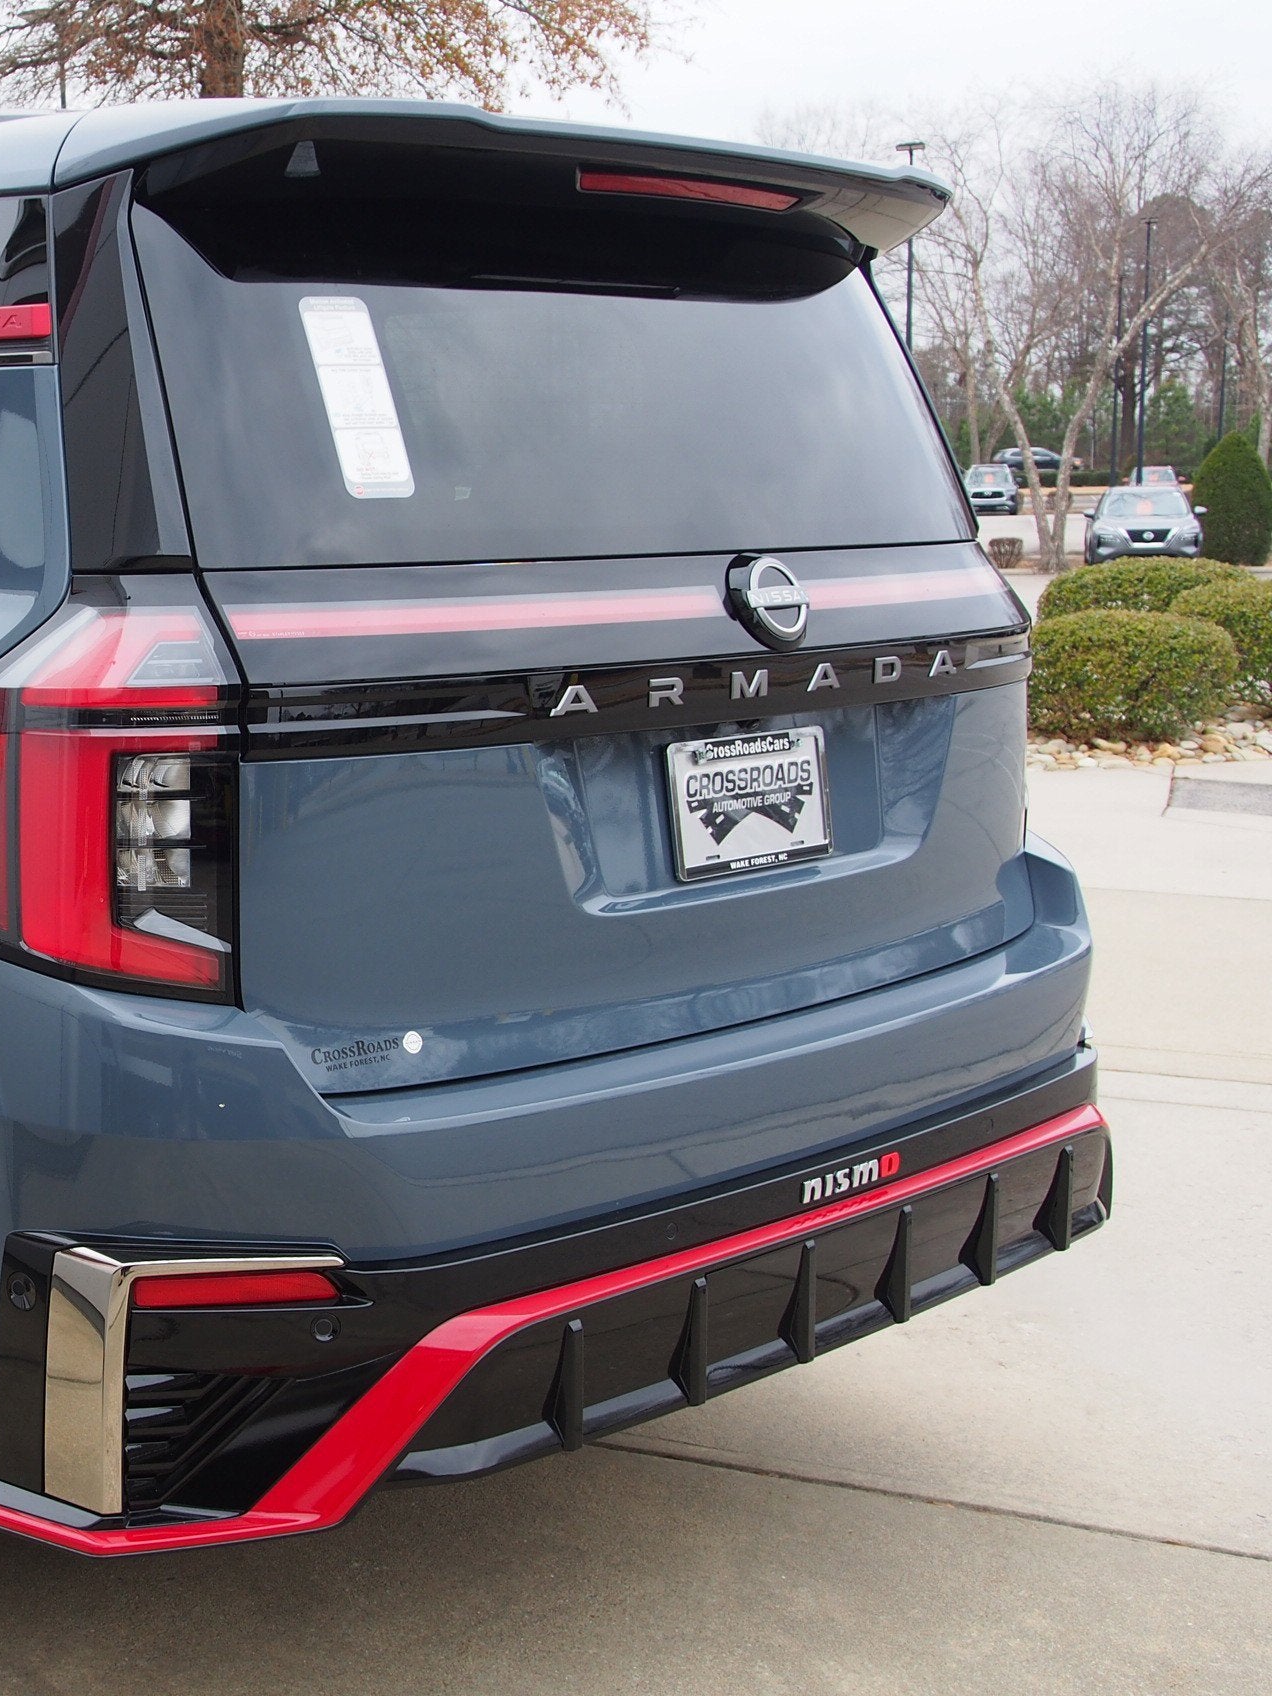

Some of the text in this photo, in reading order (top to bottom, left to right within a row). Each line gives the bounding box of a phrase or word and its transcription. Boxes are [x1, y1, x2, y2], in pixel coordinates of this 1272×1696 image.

[751, 589, 808, 604] NISSAN
[549, 649, 958, 717] ARMADA
[705, 737, 790, 760] CrossRoadsCars
[686, 759, 812, 799] CROSSROADS
[712, 791, 792, 813] AUTOMOTIVE GROUP
[730, 852, 789, 870] WAKE FOREST, NC
[325, 1053, 391, 1073] WAKE FOREST, NC
[801, 1151, 900, 1205] nismo
